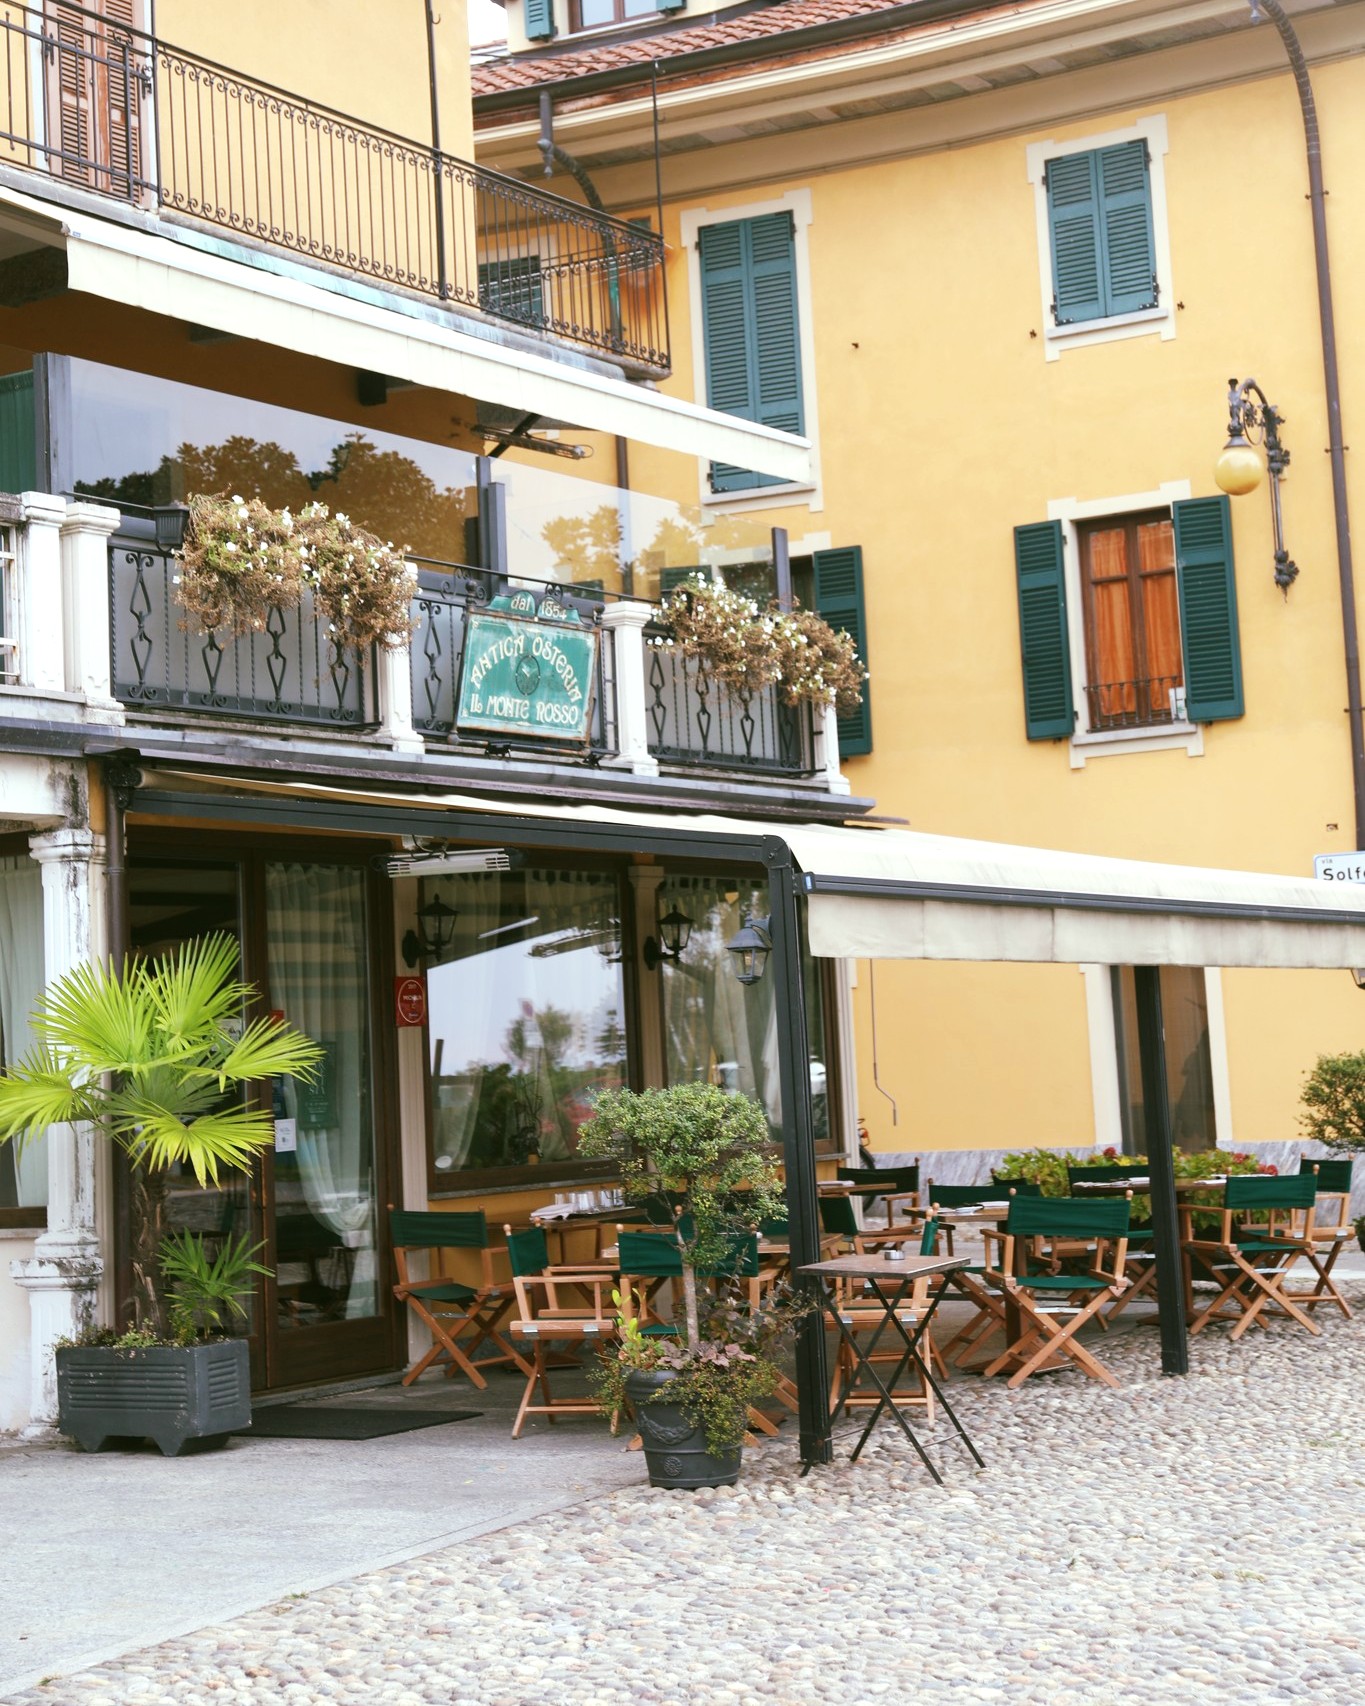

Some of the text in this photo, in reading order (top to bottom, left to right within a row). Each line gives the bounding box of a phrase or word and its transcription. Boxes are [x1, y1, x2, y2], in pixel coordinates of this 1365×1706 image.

[510, 596, 567, 620] dal 1854
[470, 634, 583, 703] ANTICA OSTERIA
[470, 693, 579, 725] IL MONTE ROSSO
[1323, 867, 1365, 881] Solf
